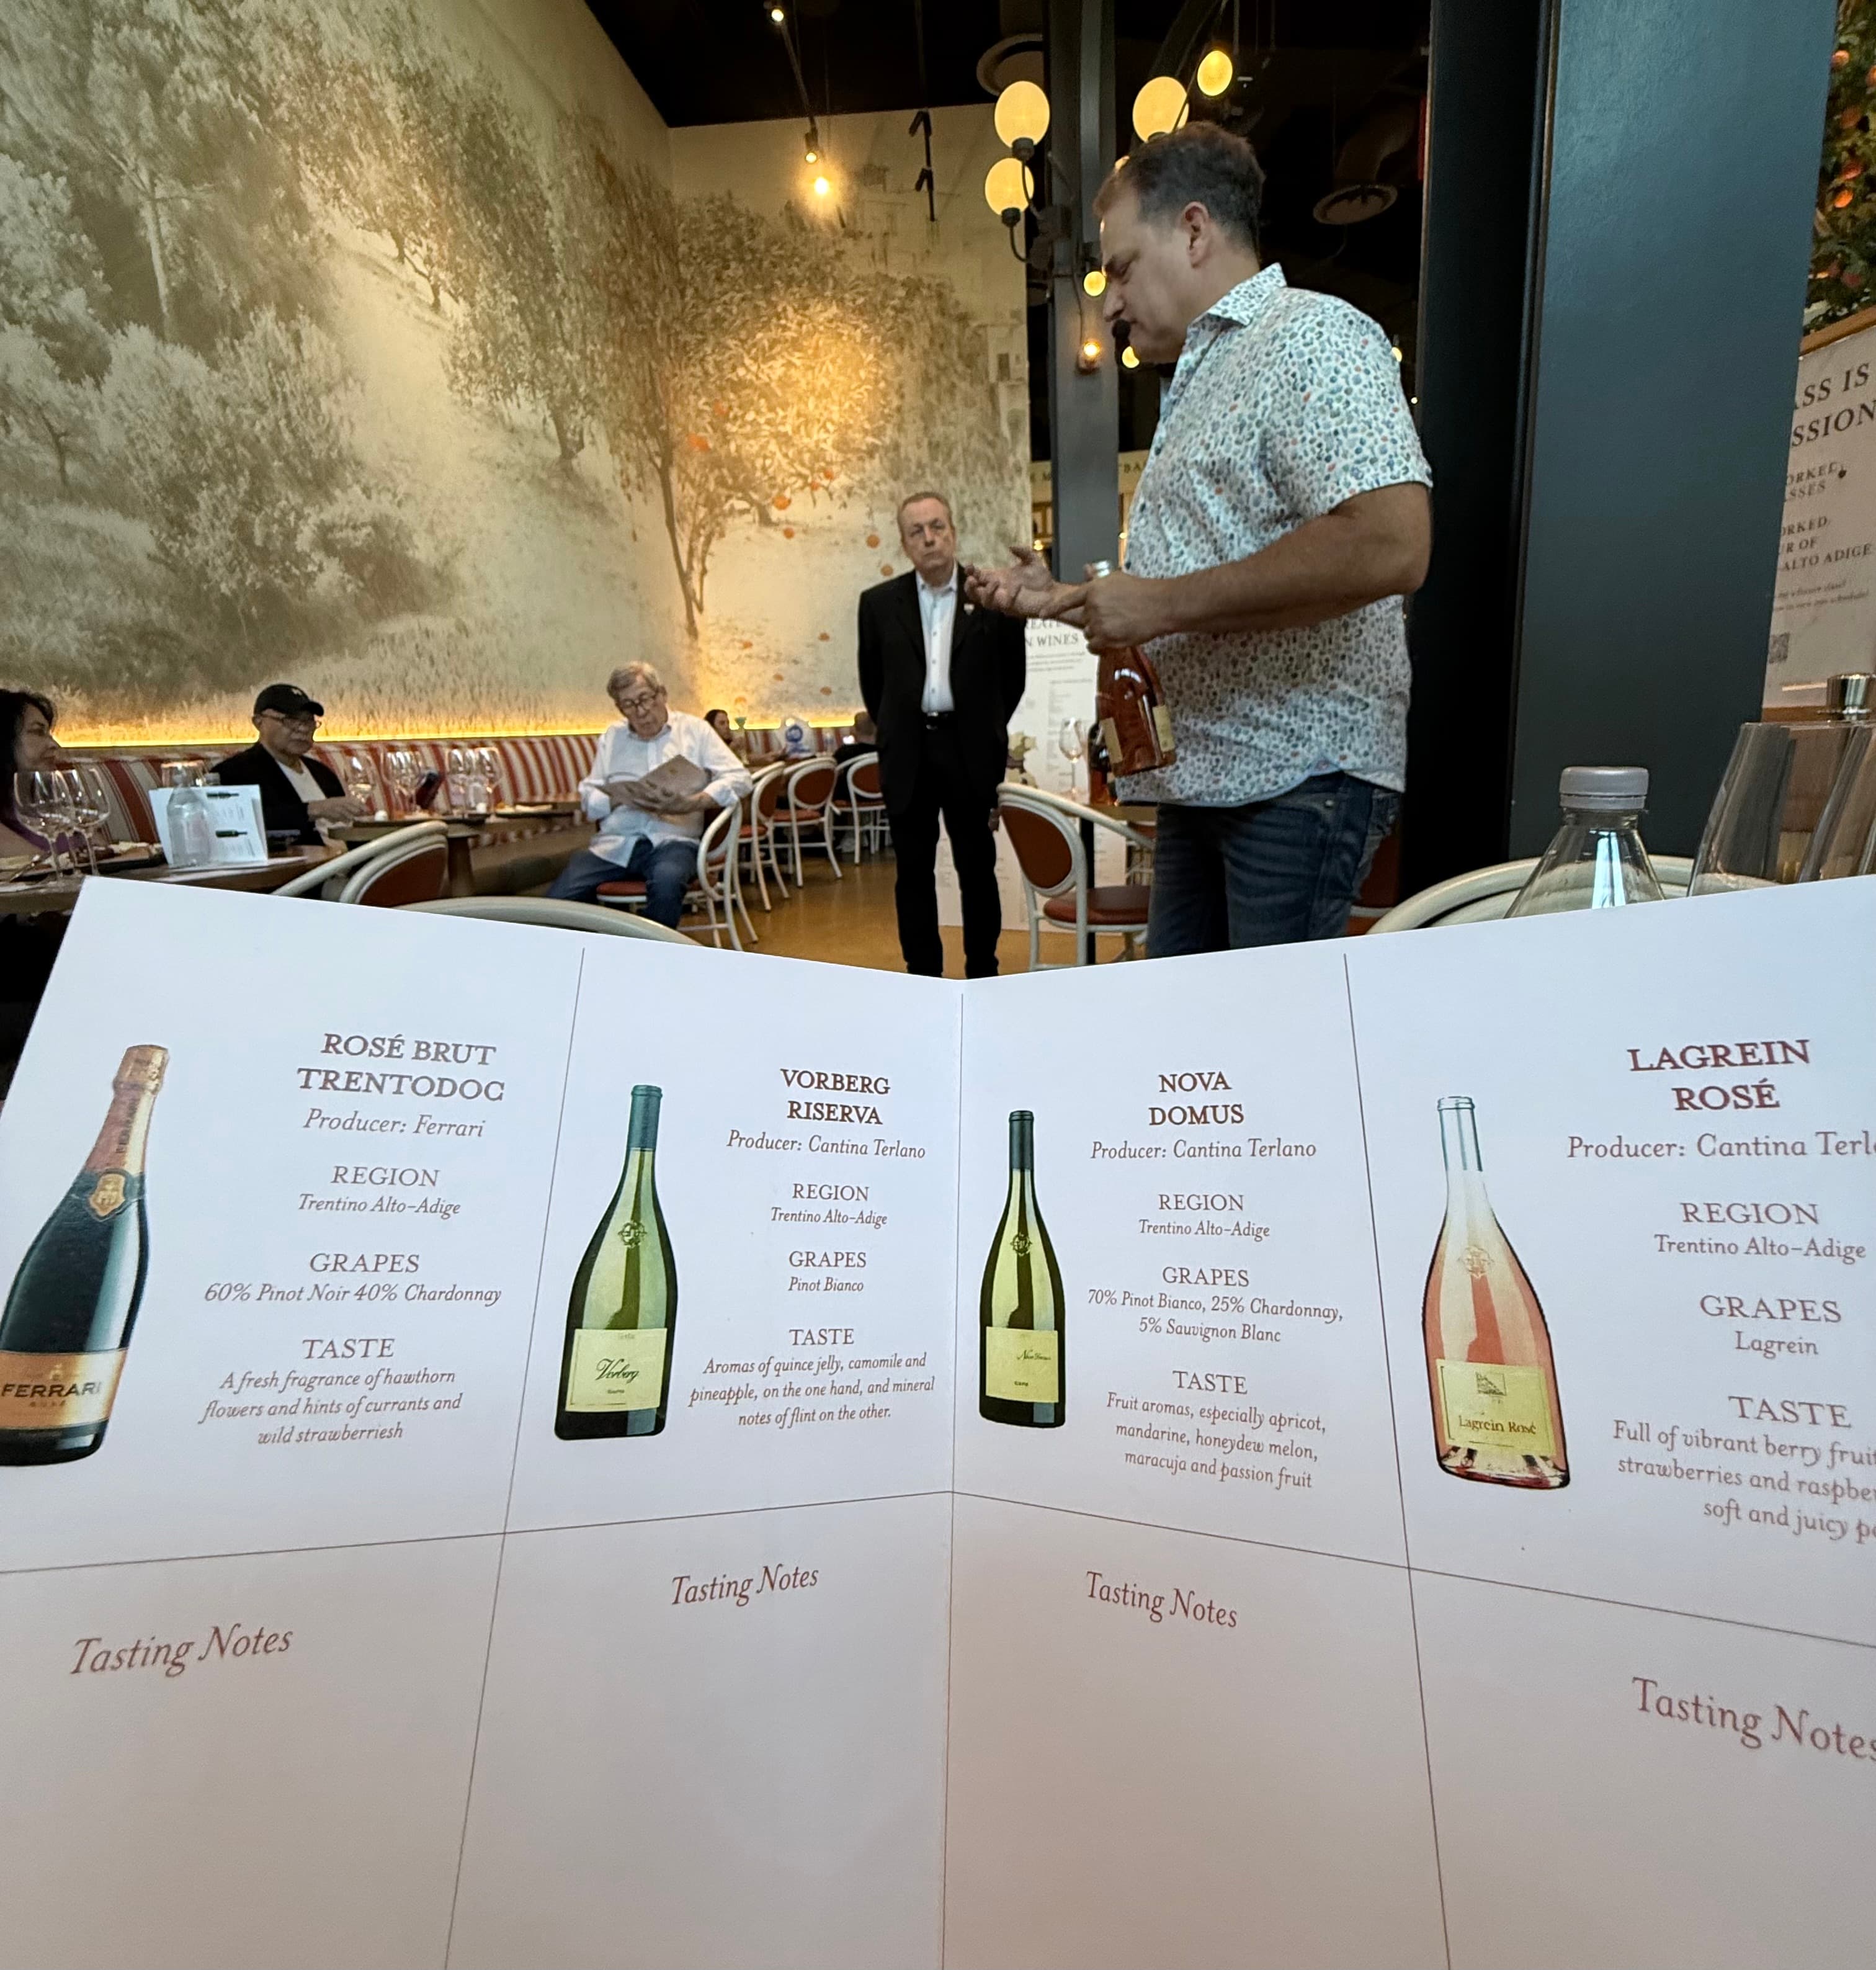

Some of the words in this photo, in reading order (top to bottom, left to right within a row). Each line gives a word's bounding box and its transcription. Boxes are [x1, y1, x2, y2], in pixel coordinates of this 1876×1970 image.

[1795, 377, 1831, 409] SS
[1842, 362, 1869, 392] IS
[1799, 536, 1818, 550] OF
[1824, 543, 1872, 564] ADIGE
[1037, 633, 1078, 647] WINES
[321, 1033, 404, 1059] ROSÉ
[411, 1041, 496, 1065] BRUT
[1627, 1039, 1810, 1071] LAGREIN
[297, 1068, 504, 1101] TRENTODOC
[780, 1068, 890, 1095] VORBERG
[1159, 1072, 1232, 1092] NOVA
[1671, 1078, 1780, 1111] ROSÉ
[303, 1108, 406, 1133] Producer:
[413, 1114, 486, 1137] Ferrari
[787, 1101, 883, 1124] RISERVA
[1148, 1104, 1244, 1126] DOMUS
[726, 1129, 802, 1150] Producer:
[809, 1135, 867, 1155] Cantina
[873, 1139, 925, 1158] Terlano
[1091, 1140, 1166, 1158] Producer:
[1174, 1139, 1241, 1158] Cantina
[1248, 1137, 1316, 1157] Terlano
[1568, 1135, 1684, 1158] Producer:
[1697, 1133, 1807, 1157] Cantina
[1815, 1131, 1876, 1155] Terl
[331, 1166, 440, 1186] REGION
[299, 1194, 367, 1211] Trentino
[792, 1184, 869, 1201] REGION
[1159, 1194, 1243, 1211] REGION
[772, 1207, 821, 1222] Trentino
[1680, 1202, 1818, 1224] REGION
[1139, 1219, 1191, 1234] Trentino
[1654, 1234, 1738, 1255] Trentino
[310, 1253, 419, 1273] GRAPES
[789, 1251, 866, 1268] GRAPES
[788, 1276, 820, 1291] Pinot
[823, 1277, 864, 1291] Bianco
[1163, 1267, 1249, 1287] GRAPES
[205, 1283, 251, 1301] 60%
[256, 1284, 304, 1301] Pinot
[307, 1284, 351, 1301] Noir
[354, 1284, 398, 1301] 40%
[405, 1284, 501, 1307] Chardonnay
[1089, 1289, 1117, 1305] 70%
[1122, 1291, 1153, 1307] Pinot
[1158, 1293, 1205, 1313] Bianco,
[1211, 1296, 1244, 1313] 25%
[1251, 1298, 1342, 1324] Chardonnay,
[1700, 1295, 1841, 1323] GRAPES
[789, 1328, 854, 1345] TASTE
[1140, 1317, 1161, 1333] 5%
[1166, 1319, 1236, 1343] Sauvignon
[1241, 1323, 1280, 1341] Blanc
[303, 1338, 395, 1359] TASTE
[1735, 1331, 1818, 1359] Lagrein
[703, 1358, 755, 1374] Aromas
[758, 1356, 774, 1377] of
[774, 1358, 813, 1377] quince
[813, 1355, 843, 1376] jelly,
[849, 1353, 902, 1369] camomile
[905, 1351, 927, 1367] and
[1, 1382, 101, 1397] FERRARI
[219, 1372, 233, 1389] A
[233, 1371, 279, 1395] fresh
[278, 1370, 360, 1394] fragrance
[365, 1368, 385, 1390] of
[383, 1368, 455, 1384] hawthorn
[688, 1383, 757, 1407] pineapple,
[763, 1388, 779, 1398] on
[783, 1382, 801, 1397] the
[805, 1387, 826, 1396] one
[830, 1379, 862, 1395] hand,
[868, 1377, 890, 1393] and
[893, 1376, 935, 1392] mineral
[1172, 1371, 1247, 1394] TASTE
[197, 1400, 264, 1425] flowers
[268, 1398, 302, 1415] and
[303, 1397, 342, 1414] hints
[346, 1395, 367, 1418] of
[365, 1397, 429, 1412] currants
[433, 1392, 463, 1410] and
[739, 1412, 771, 1425] notes
[775, 1407, 790, 1429] of
[787, 1407, 816, 1428] flint
[819, 1412, 834, 1421] on
[838, 1405, 855, 1420] the
[859, 1404, 890, 1418] other.
[1107, 1392, 1138, 1410] Fruit
[1142, 1402, 1194, 1419] aromas,
[1200, 1406, 1264, 1430] especially
[1269, 1413, 1325, 1434] apricot,
[1728, 1396, 1851, 1428] TASTE
[258, 1425, 295, 1444] wild
[295, 1422, 403, 1443] strawberriesh
[1458, 1415, 1504, 1432] Lagrein
[1117, 1423, 1189, 1446] mandarine,
[1196, 1428, 1264, 1454] honeydew
[1269, 1439, 1317, 1462] melon,
[1614, 1420, 1650, 1442] Full
[1658, 1425, 1679, 1452] of
[1682, 1428, 1758, 1453] vibrant
[1763, 1435, 1821, 1467] berry
[1125, 1453, 1186, 1475] maracuja
[1191, 1458, 1217, 1474] and
[1219, 1462, 1273, 1483] passion
[1275, 1467, 1311, 1490] fruit
[1618, 1457, 1742, 1485] strawberries
[1749, 1471, 1790, 1492] and
[1704, 1498, 1741, 1526] soft
[1749, 1505, 1790, 1526] and
[1792, 1510, 1847, 1541] juicy
[672, 1574, 753, 1607] Tasting
[756, 1564, 818, 1593] Notes
[1087, 1571, 1164, 1623] Tasting
[1169, 1588, 1236, 1627] Notes
[70, 1636, 195, 1678] Tasting
[198, 1623, 293, 1661] Notes
[1632, 1677, 1762, 1749] Tasting
